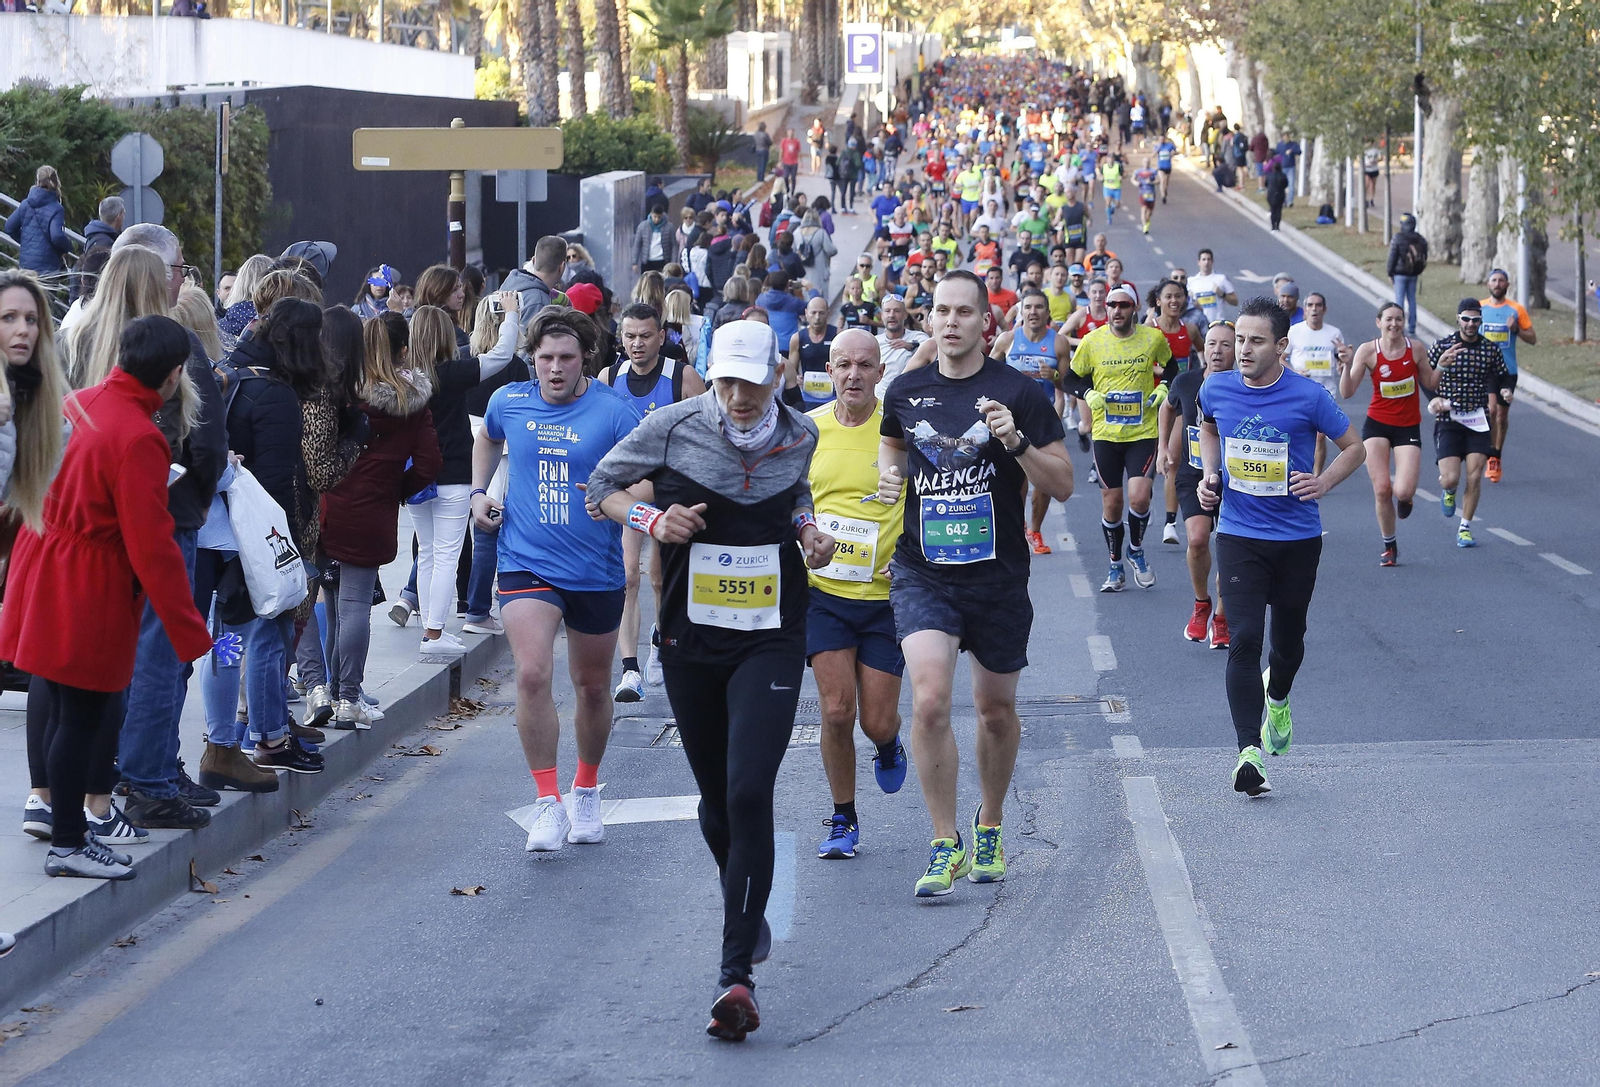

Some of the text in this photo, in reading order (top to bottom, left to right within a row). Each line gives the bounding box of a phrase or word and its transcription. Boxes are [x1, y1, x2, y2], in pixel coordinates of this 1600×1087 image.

[853, 35, 876, 65] P
[538, 423, 565, 431] ZURICH
[1236, 413, 1262, 439] SOUTH
[537, 447, 553, 455] 21K
[539, 460, 569, 482] RUN
[1243, 462, 1267, 473] 5561
[538, 482, 569, 504] AND
[539, 503, 569, 525] SUN
[948, 504, 977, 512] ZURICH
[841, 524, 869, 535] ZURICH
[945, 523, 970, 536] 642
[736, 555, 769, 565] ZURICH
[718, 579, 755, 595] 5551
